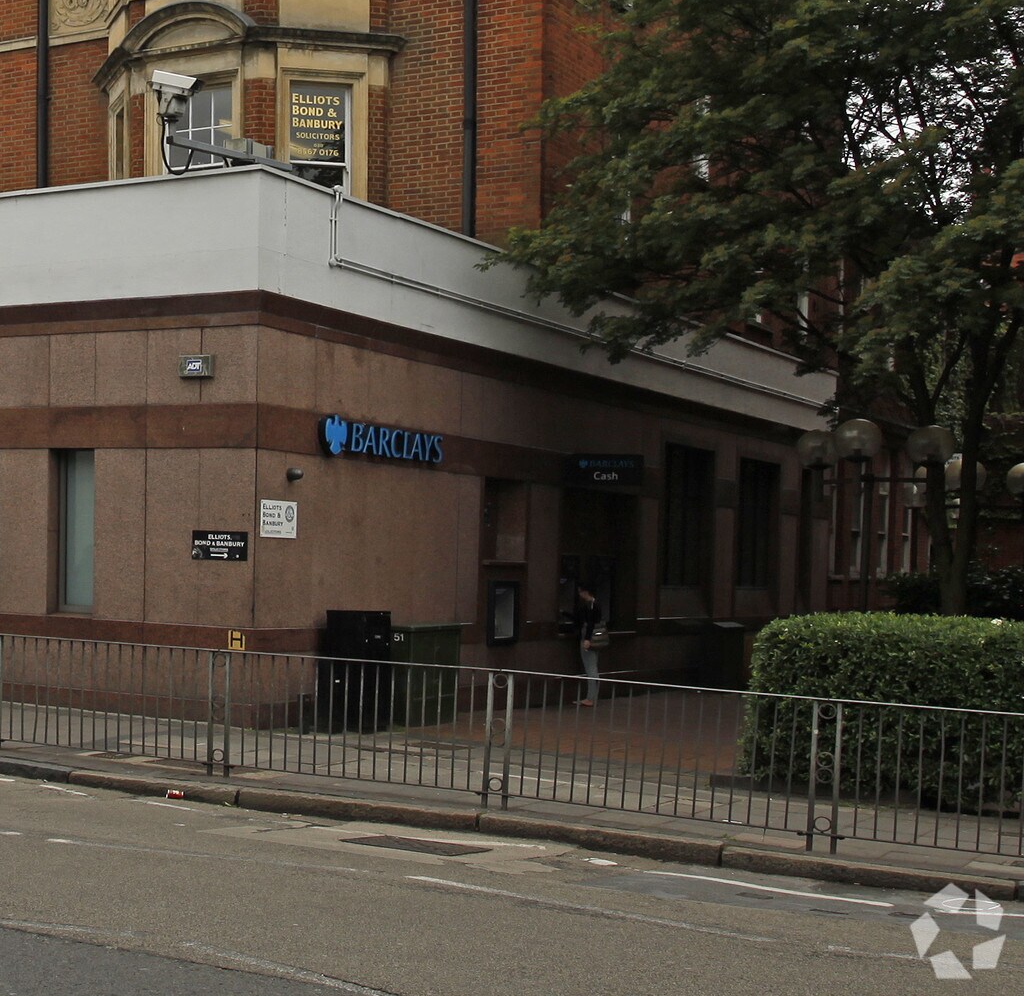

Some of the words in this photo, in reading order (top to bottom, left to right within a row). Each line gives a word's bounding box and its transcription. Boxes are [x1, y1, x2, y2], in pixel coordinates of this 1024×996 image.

[292, 93, 340, 106] ELLIOTS
[292, 105, 324, 117] BOND
[327, 108, 337, 118] &
[292, 117, 343, 130] BANBURY
[296, 132, 340, 141] SOLICITORS
[318, 148, 340, 157] 0176
[186, 362, 202, 371] ADT
[350, 422, 444, 464] BARCLAYS
[593, 471, 619, 481] Cash
[230, 631, 243, 648] H
[393, 633, 404, 642] 51
